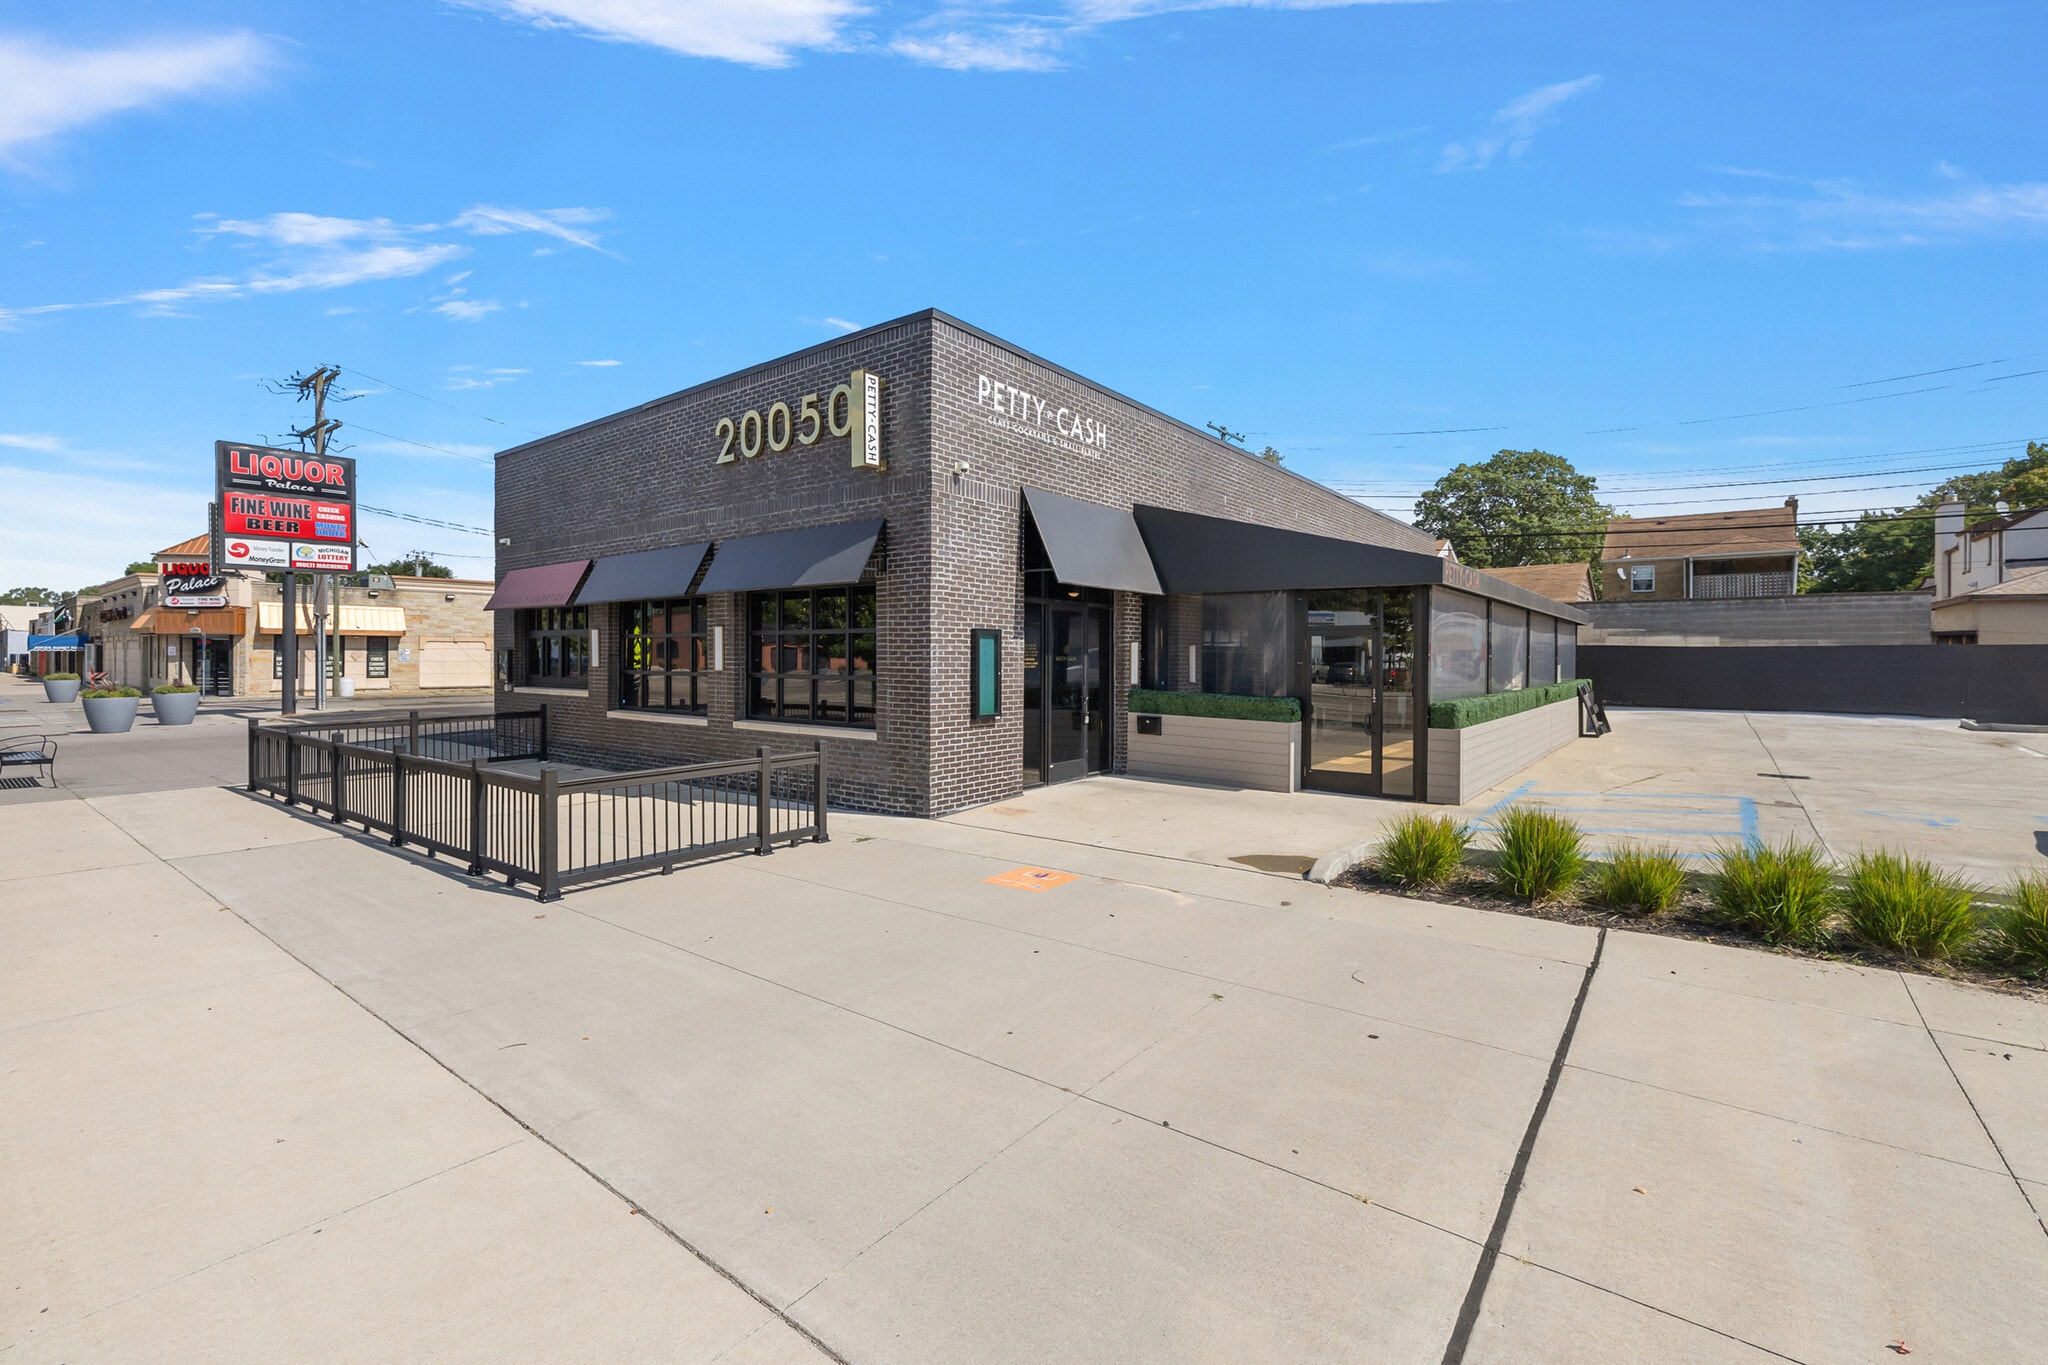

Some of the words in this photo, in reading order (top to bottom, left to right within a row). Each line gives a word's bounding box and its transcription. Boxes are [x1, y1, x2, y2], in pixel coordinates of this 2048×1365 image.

[867, 376, 877, 418] PETTY
[978, 374, 1046, 426] PETTY
[1056, 407, 1107, 449] CASH
[715, 383, 852, 464] 20050
[987, 415, 1010, 430] CRAFT
[1013, 424, 1051, 443] COCKTAILS
[1060, 439, 1080, 453] SMALL
[867, 424, 877, 462] CASH
[230, 450, 346, 486] LIQUOR
[265, 478, 316, 493] Palace
[231, 497, 266, 516] FINE
[269, 500, 311, 520] WINE
[317, 506, 340, 514] CHECK
[316, 513, 346, 521] CASHING
[246, 518, 300, 533] BEER
[315, 521, 347, 531] MONEY
[315, 529, 347, 538] ORDER
[317, 547, 349, 555] MICHIGAN
[248, 556, 286, 564] MoneyGram
[162, 562, 210, 576] LIQUO
[165, 577, 219, 594] Palace
